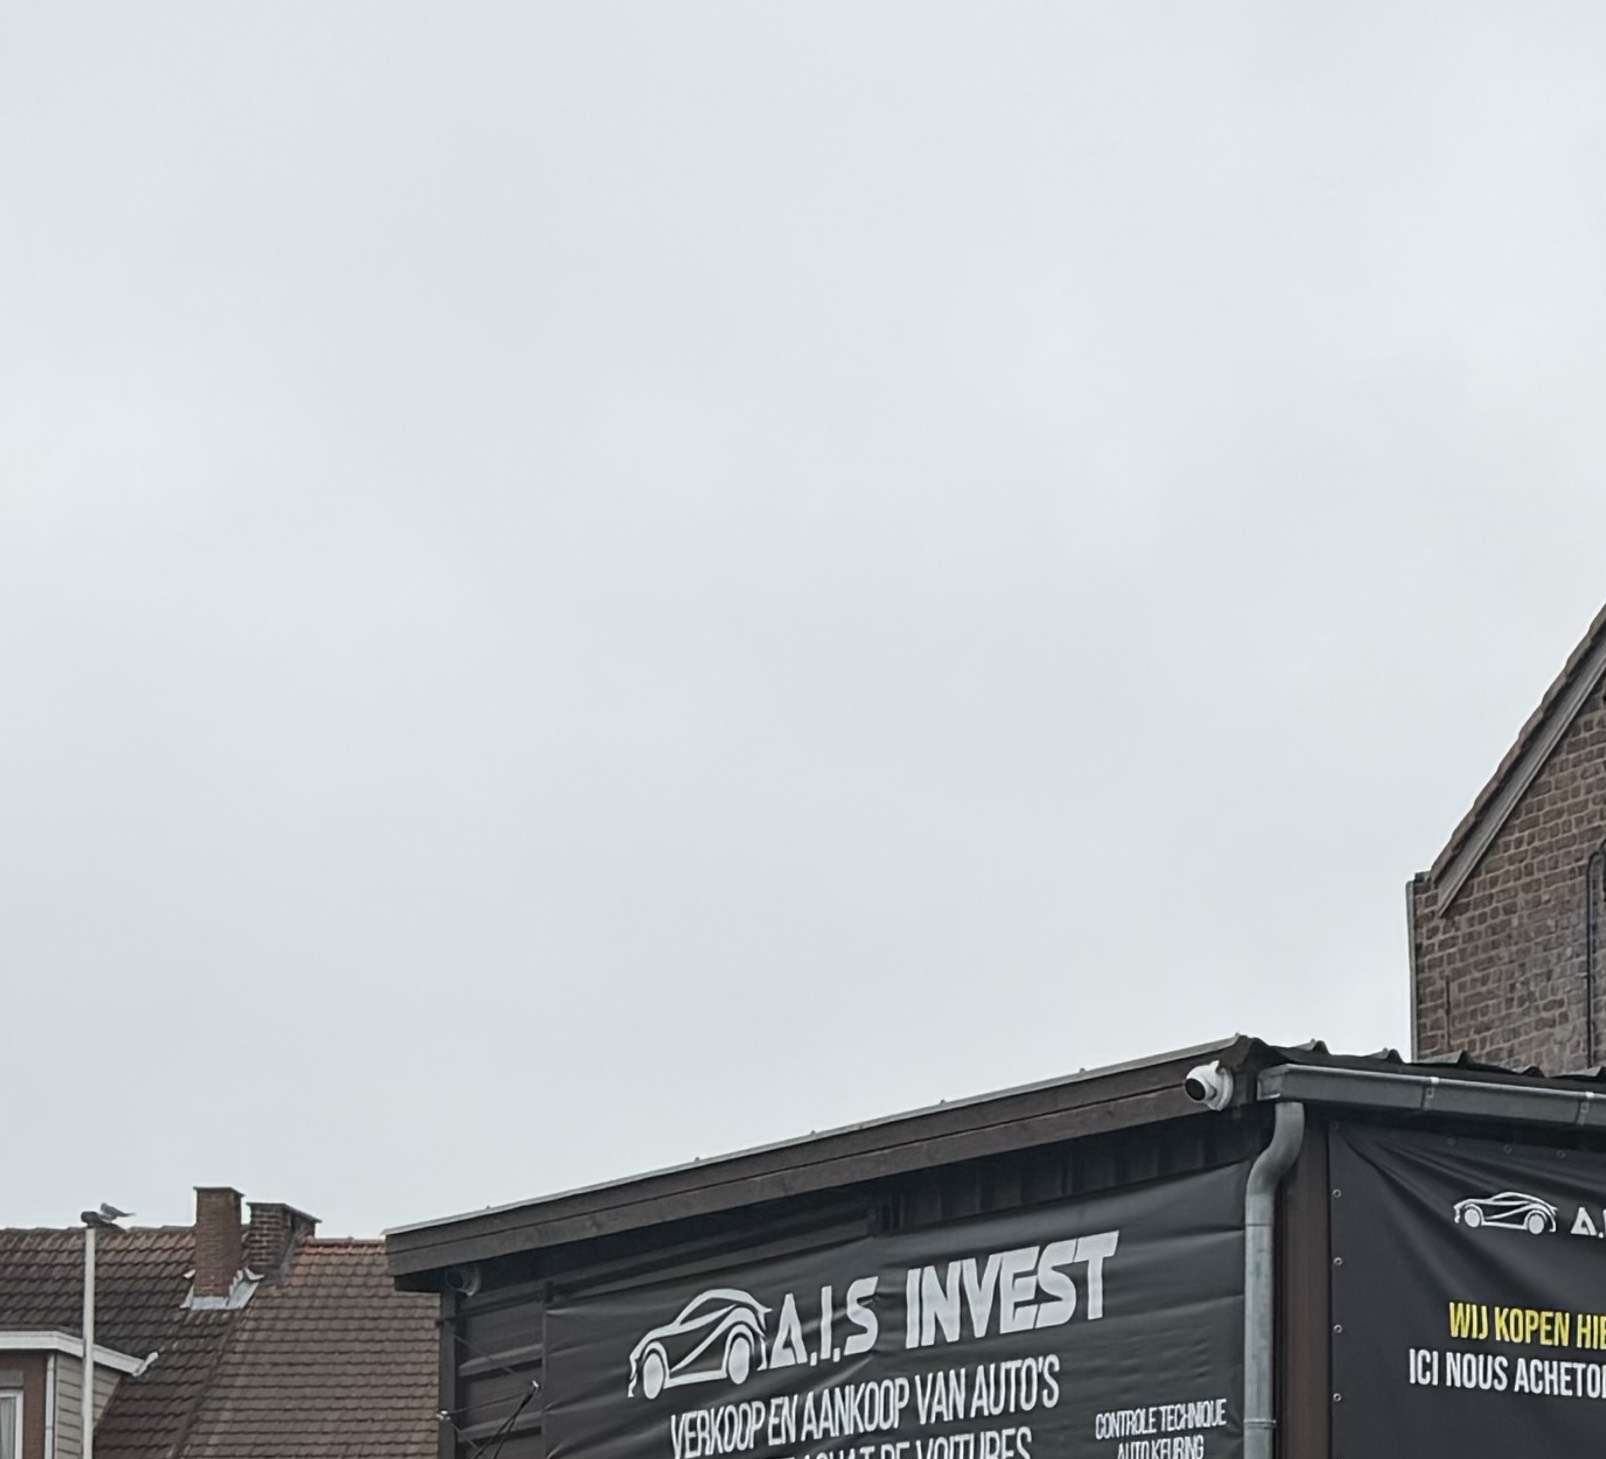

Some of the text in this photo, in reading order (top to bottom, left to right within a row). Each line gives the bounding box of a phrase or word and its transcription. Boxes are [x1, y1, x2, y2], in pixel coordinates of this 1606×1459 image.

[769, 1230, 1119, 1368] A.I.S INVEST
[1449, 1302, 1488, 1340] WIJ
[1495, 1306, 1569, 1347] KOPEN
[1409, 1348, 1439, 1386] ICI
[1445, 1352, 1507, 1392] NOUS
[767, 1392, 798, 1447] EN
[801, 1377, 908, 1442] AANKOOP
[915, 1369, 966, 1425] VAN
[970, 1353, 1060, 1419] AUTO'S
[1095, 1398, 1227, 1440] CONTROLE TECHNIQUE
